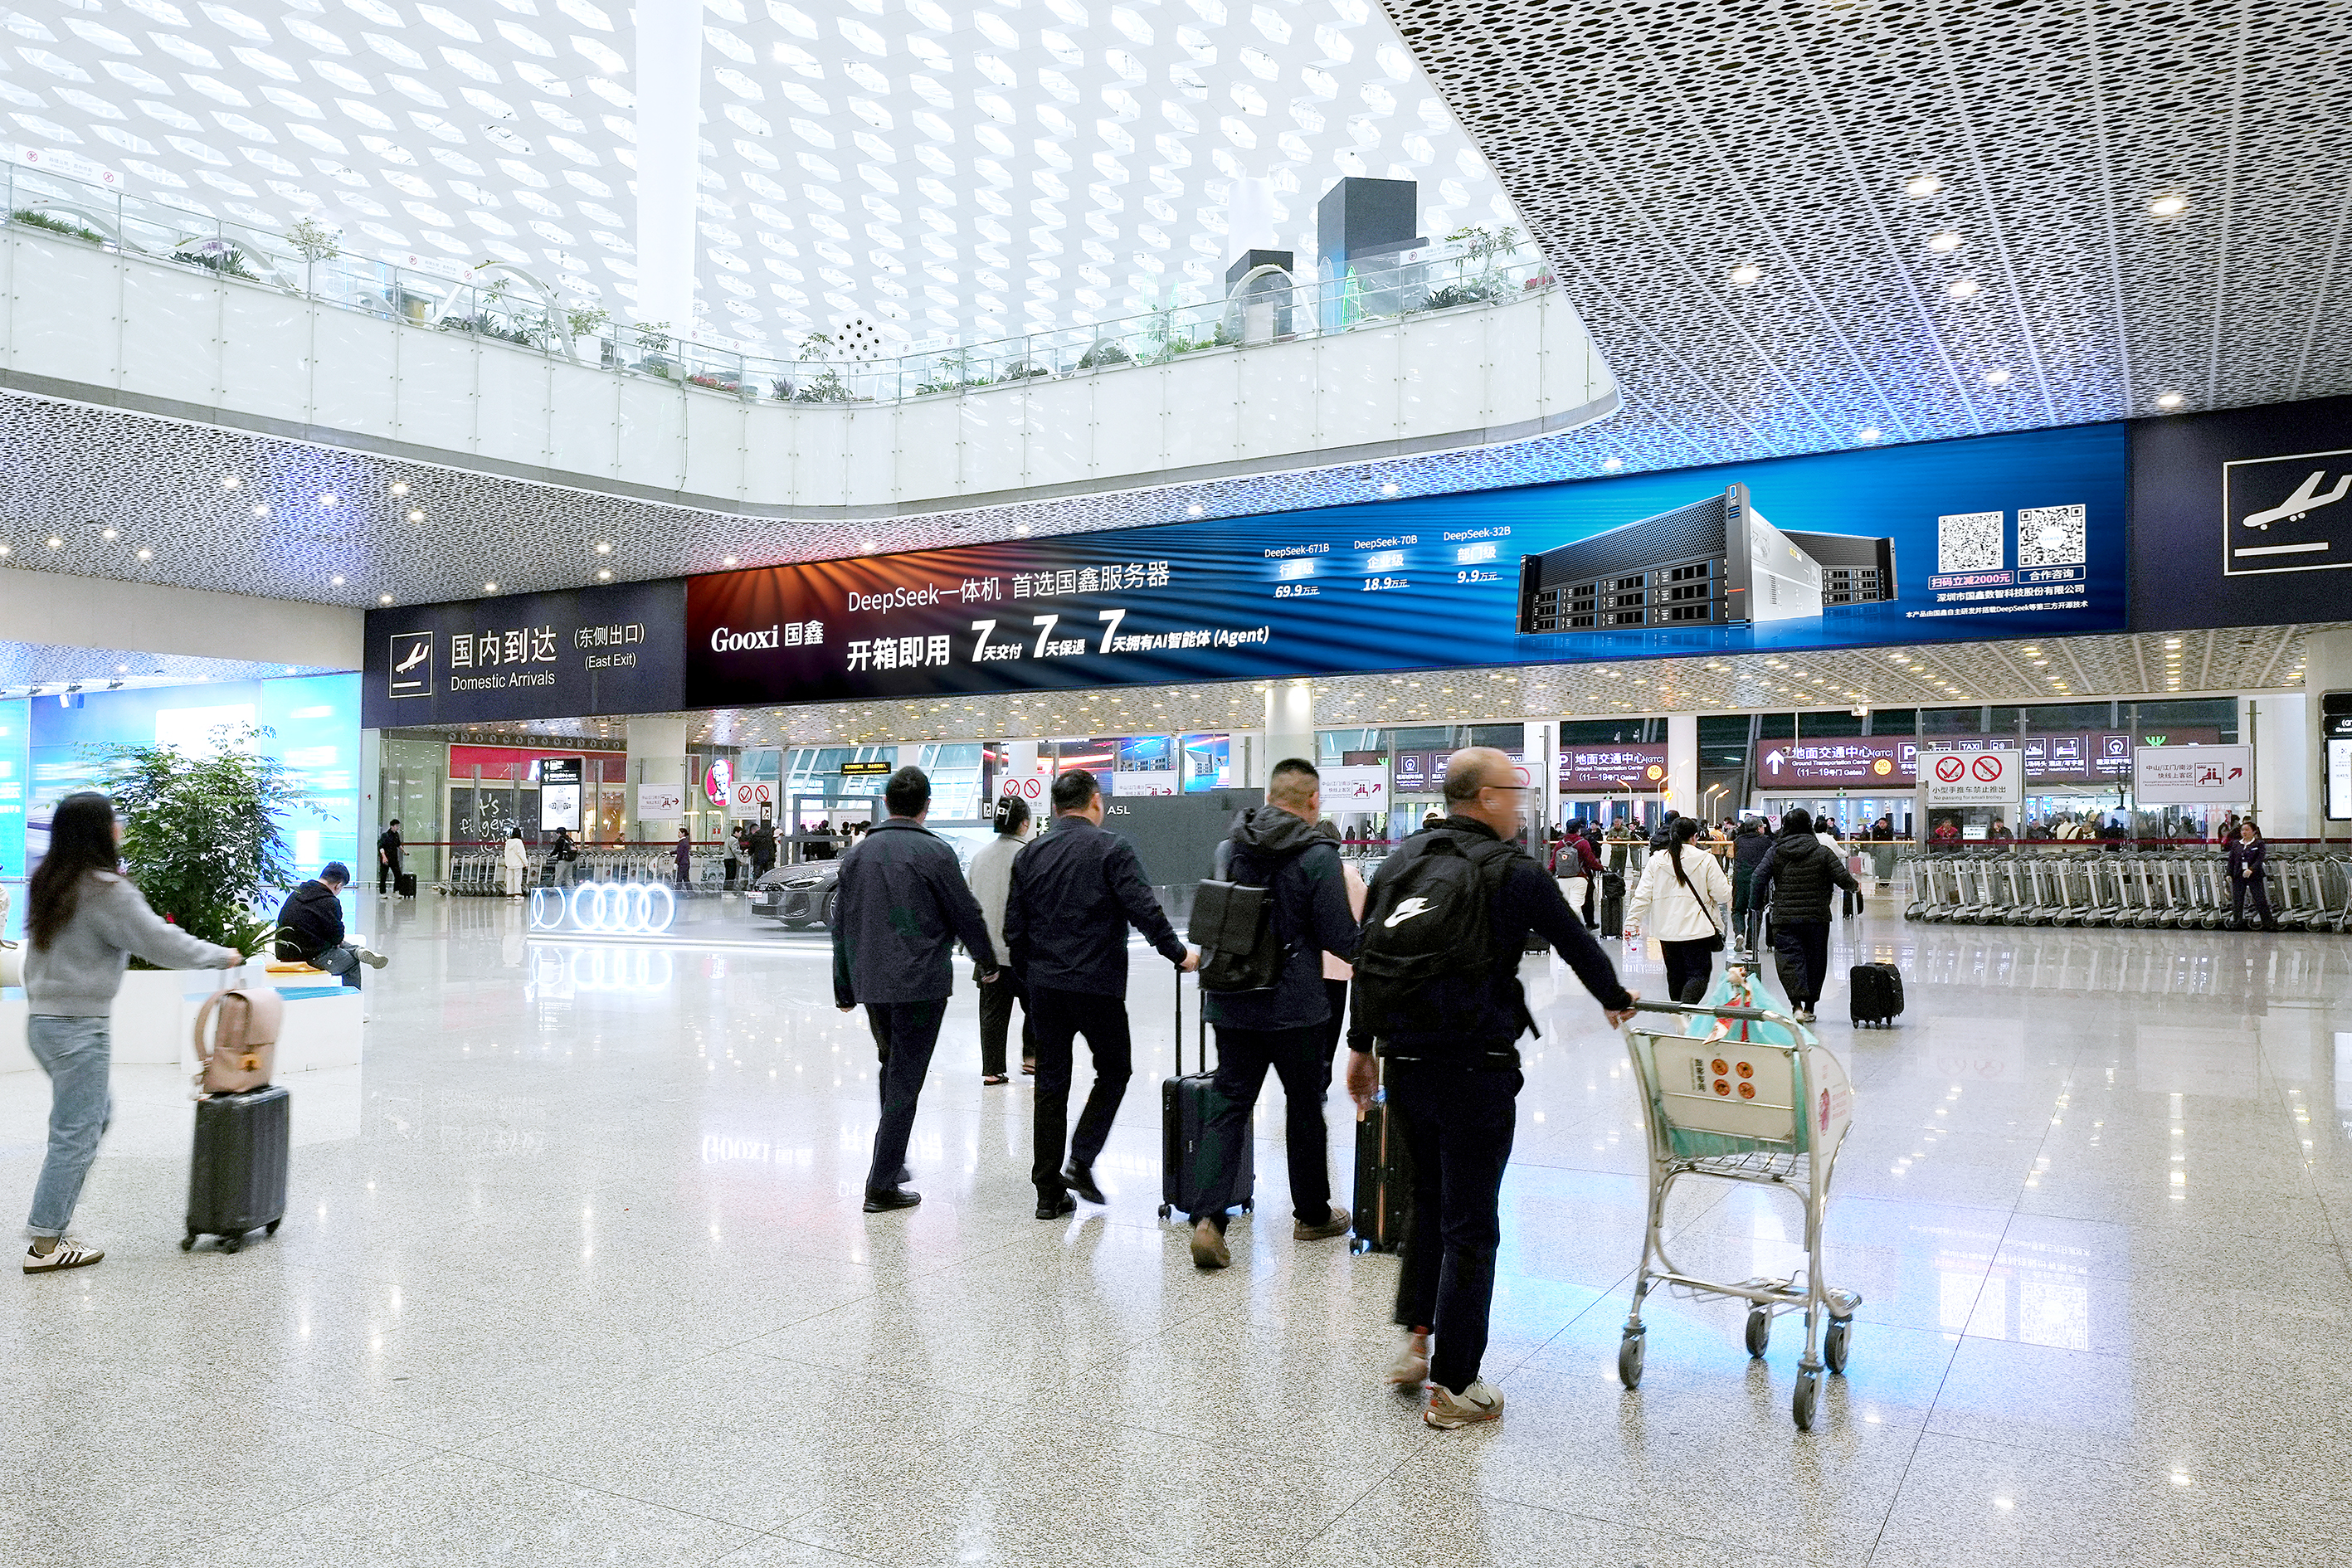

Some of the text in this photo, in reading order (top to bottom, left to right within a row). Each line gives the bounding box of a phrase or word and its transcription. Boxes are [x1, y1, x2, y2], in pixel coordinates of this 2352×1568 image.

[1354, 535, 1418, 550] DeepSeek-70B
[1444, 526, 1512, 542] DeepSeek-32B
[1264, 543, 1330, 559] DeepSeek-671B
[1457, 545, 1497, 562] 部门级
[1278, 562, 1315, 577] 行业级
[1366, 553, 1405, 570] 企业级
[1931, 573, 2011, 588] 扫码立减2000元
[2029, 568, 2074, 581] 合作咨询
[848, 560, 1171, 614] DeepSeek一体机 首选国鑫服务器
[1936, 584, 2085, 602] 深圳市国鑫数智科技股份有限公司
[711, 620, 824, 652] Gooxi 国鑫
[451, 622, 645, 669] 国内到达 (东侧出口)
[847, 634, 950, 672] 开箱即用
[585, 652, 636, 671] (East Exit)
[450, 670, 556, 691] Domestic Arrivals
[1107, 805, 1131, 816] A5L
